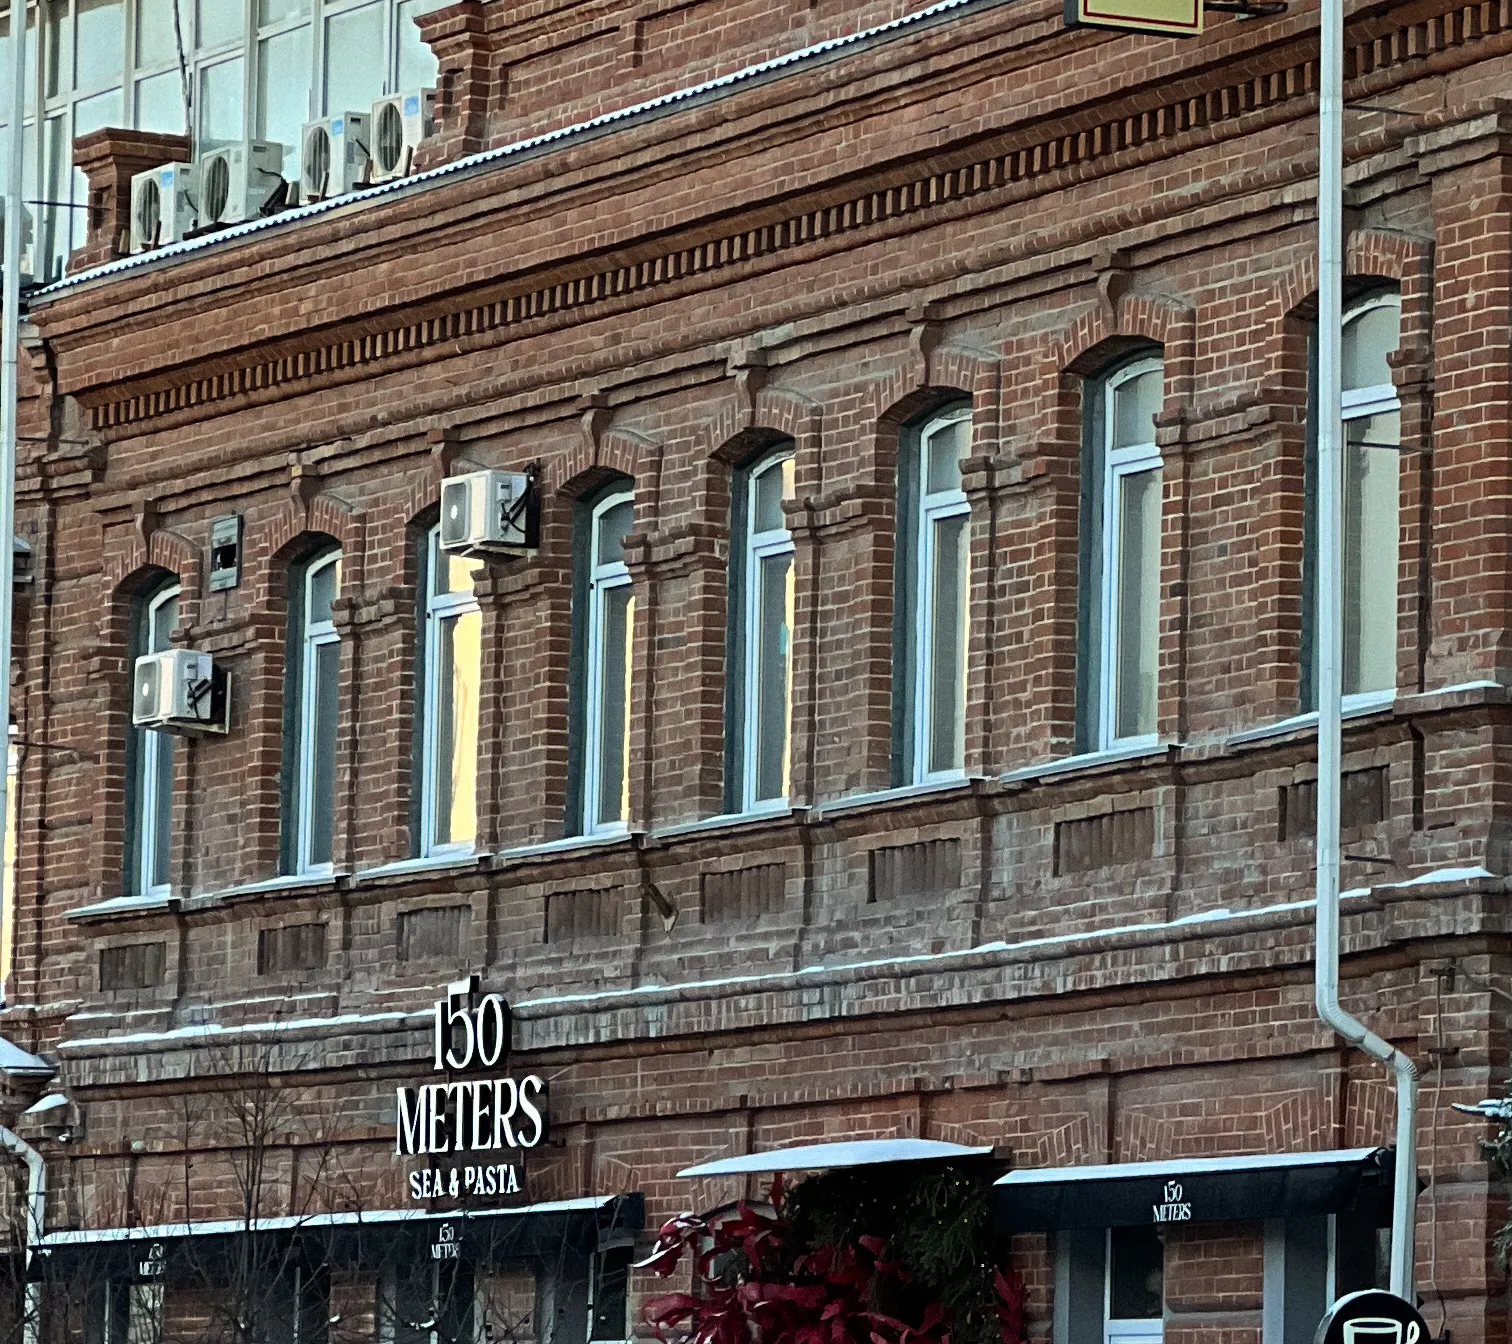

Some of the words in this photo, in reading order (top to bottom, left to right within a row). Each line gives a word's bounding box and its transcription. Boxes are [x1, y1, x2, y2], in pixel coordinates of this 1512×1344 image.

[433, 976, 504, 1070] 150
[395, 1074, 544, 1156] METERS
[409, 1168, 447, 1199] SEA
[449, 1168, 460, 1199] &
[464, 1164, 522, 1195] PASTA
[1163, 1180, 1183, 1202] 150
[1152, 1202, 1191, 1223] METERS
